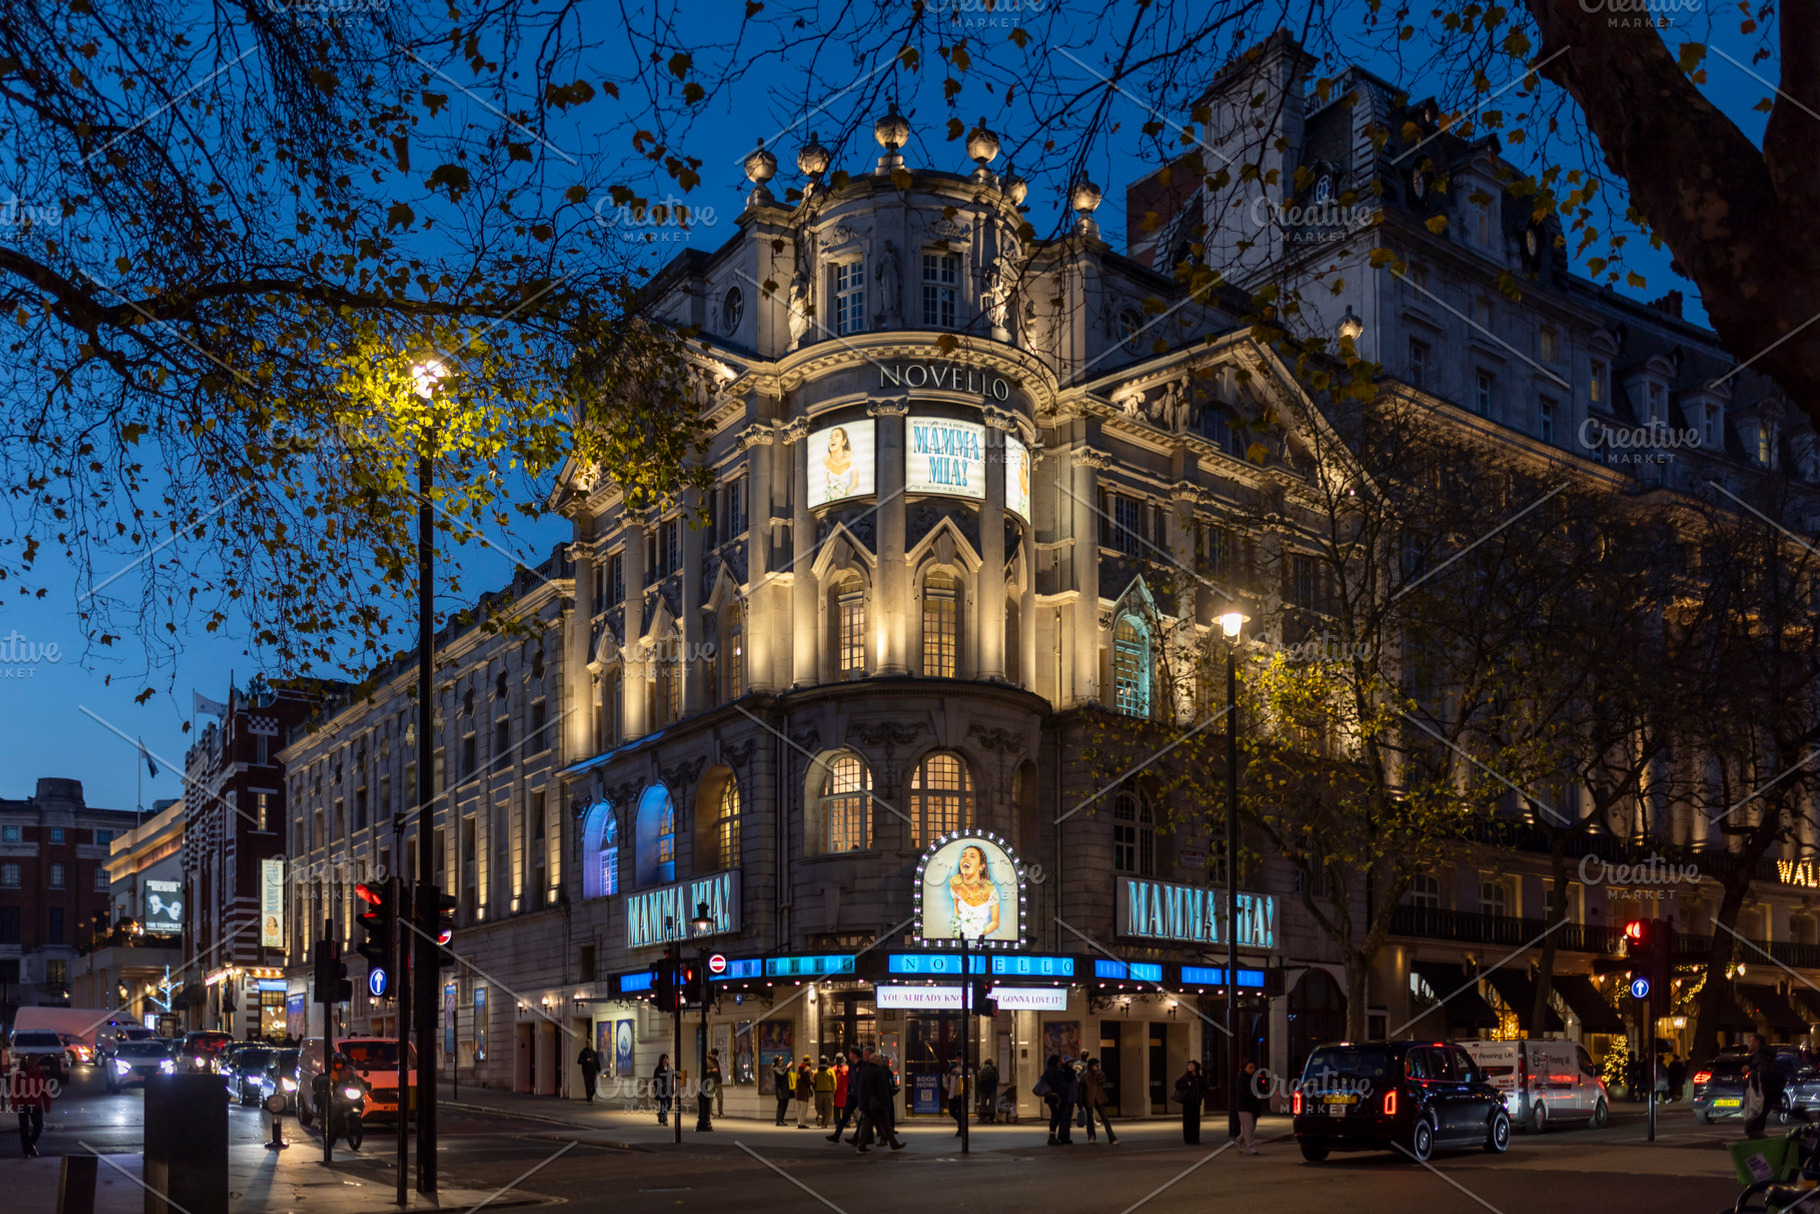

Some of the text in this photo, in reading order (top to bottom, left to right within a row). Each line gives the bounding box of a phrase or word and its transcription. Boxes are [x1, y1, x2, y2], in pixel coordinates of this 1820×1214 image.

[879, 364, 1010, 402] NOVELLO
[913, 426, 980, 460] MAMMA
[928, 456, 968, 487] MIA!
[627, 885, 687, 948] MAMMA
[1127, 880, 1218, 943] MAMMA
[905, 957, 1073, 973] NOELLO
[1002, 995, 1030, 1004] GONNA
[1030, 996, 1051, 1004] LOVE
